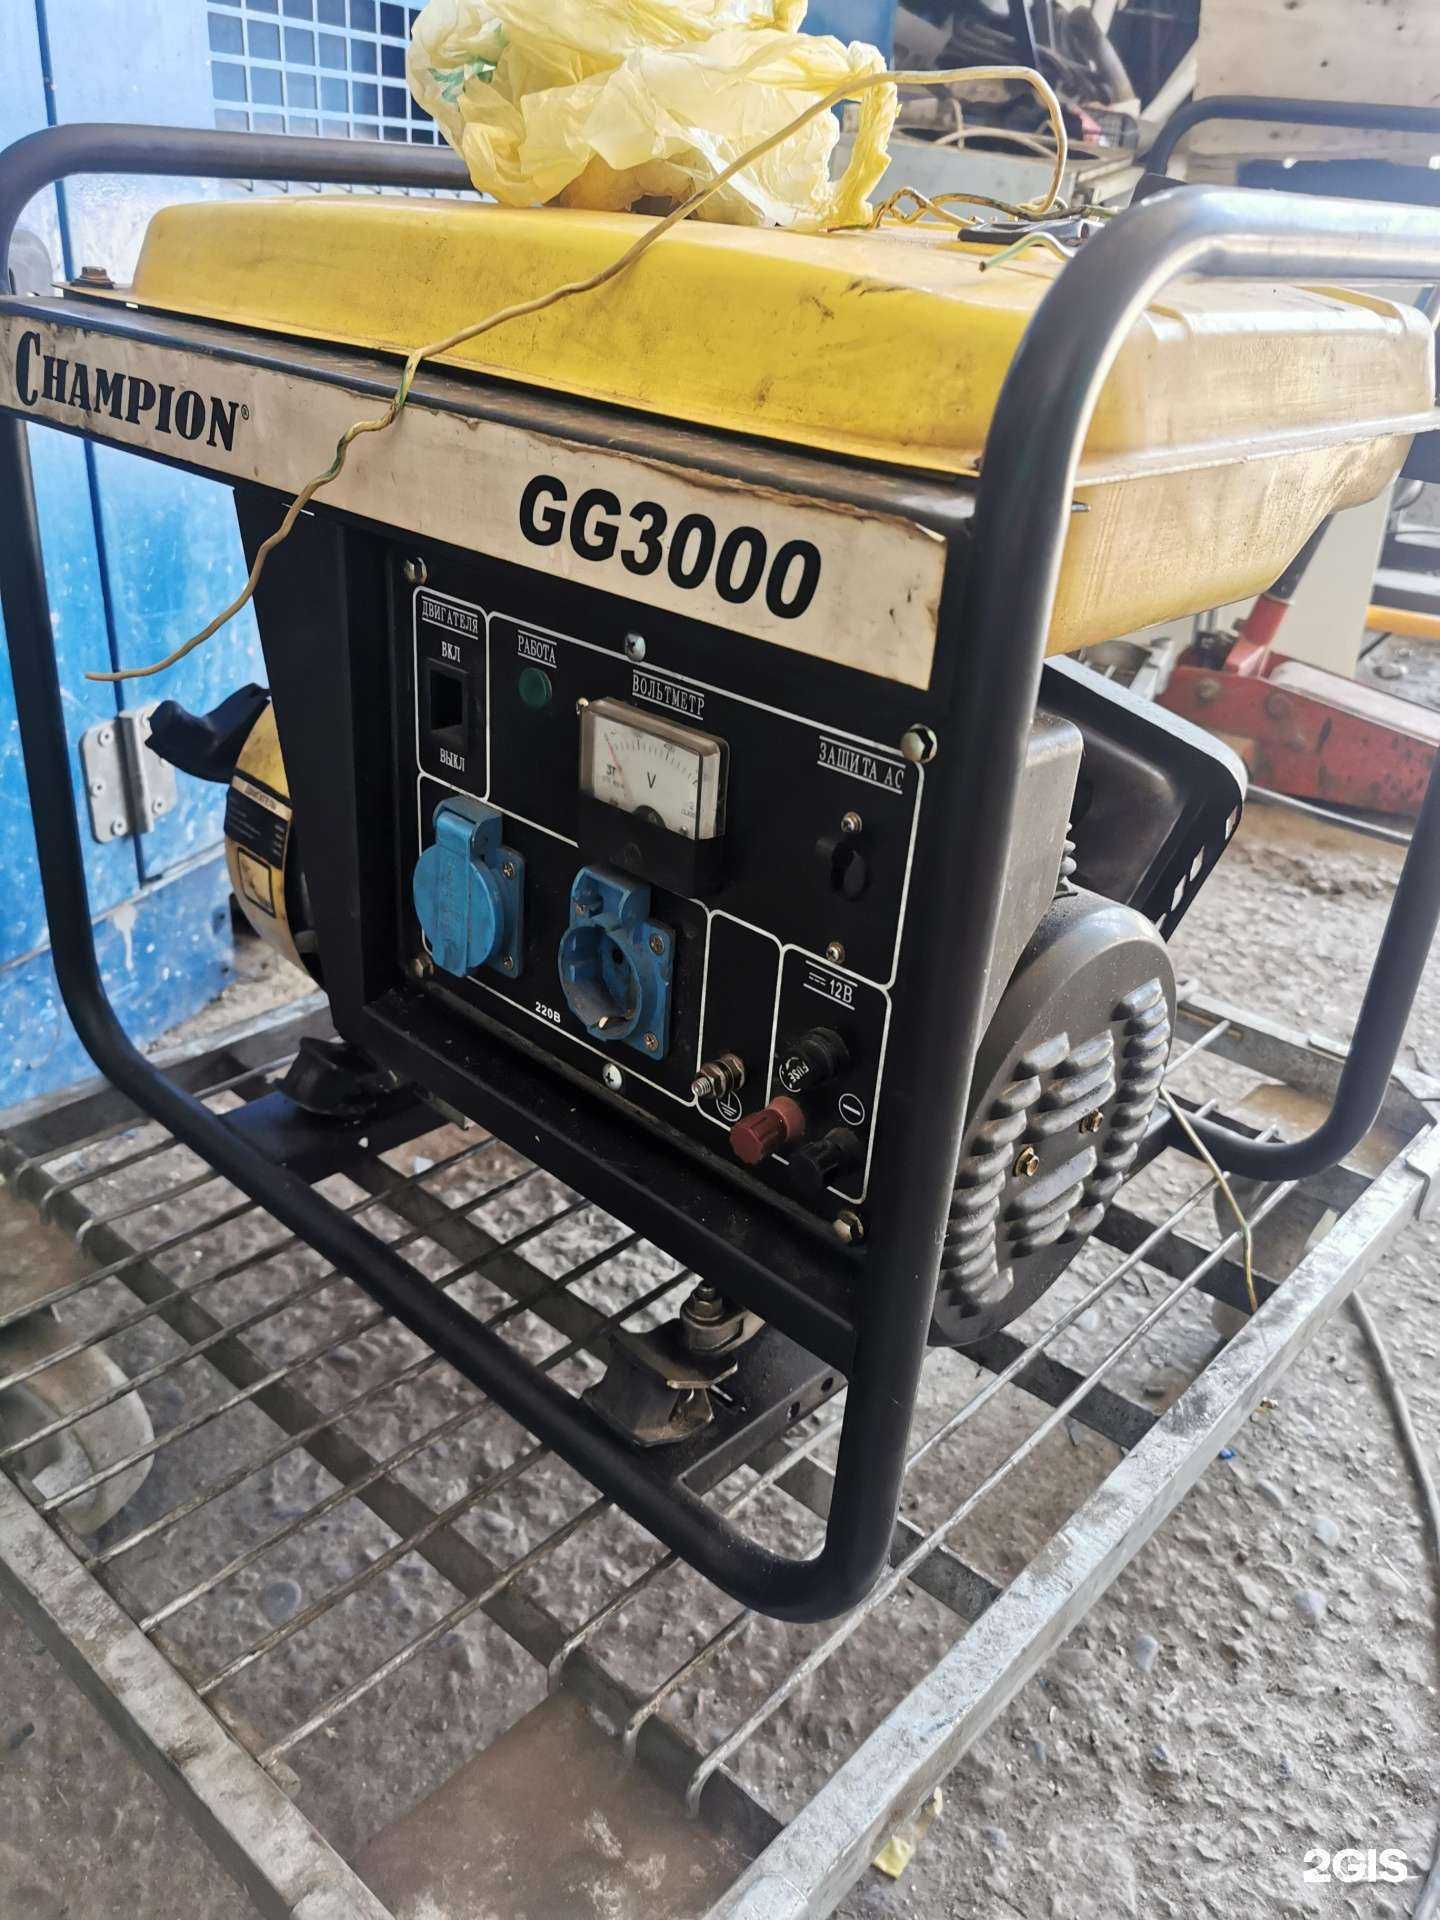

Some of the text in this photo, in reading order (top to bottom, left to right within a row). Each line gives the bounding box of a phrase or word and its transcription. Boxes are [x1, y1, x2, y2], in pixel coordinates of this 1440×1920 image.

[519, 475, 822, 619] GG3000
[422, 600, 479, 633] ДВИГАТЕЛЯ
[441, 641, 461, 663] ВКЛ
[517, 634, 556, 664] РАБОТА
[632, 674, 705, 716] ВОЛЬТМЕТР
[439, 748, 465, 772] ВЫКЛ
[647, 771, 657, 789] V
[787, 1060, 810, 1083] FUSE
